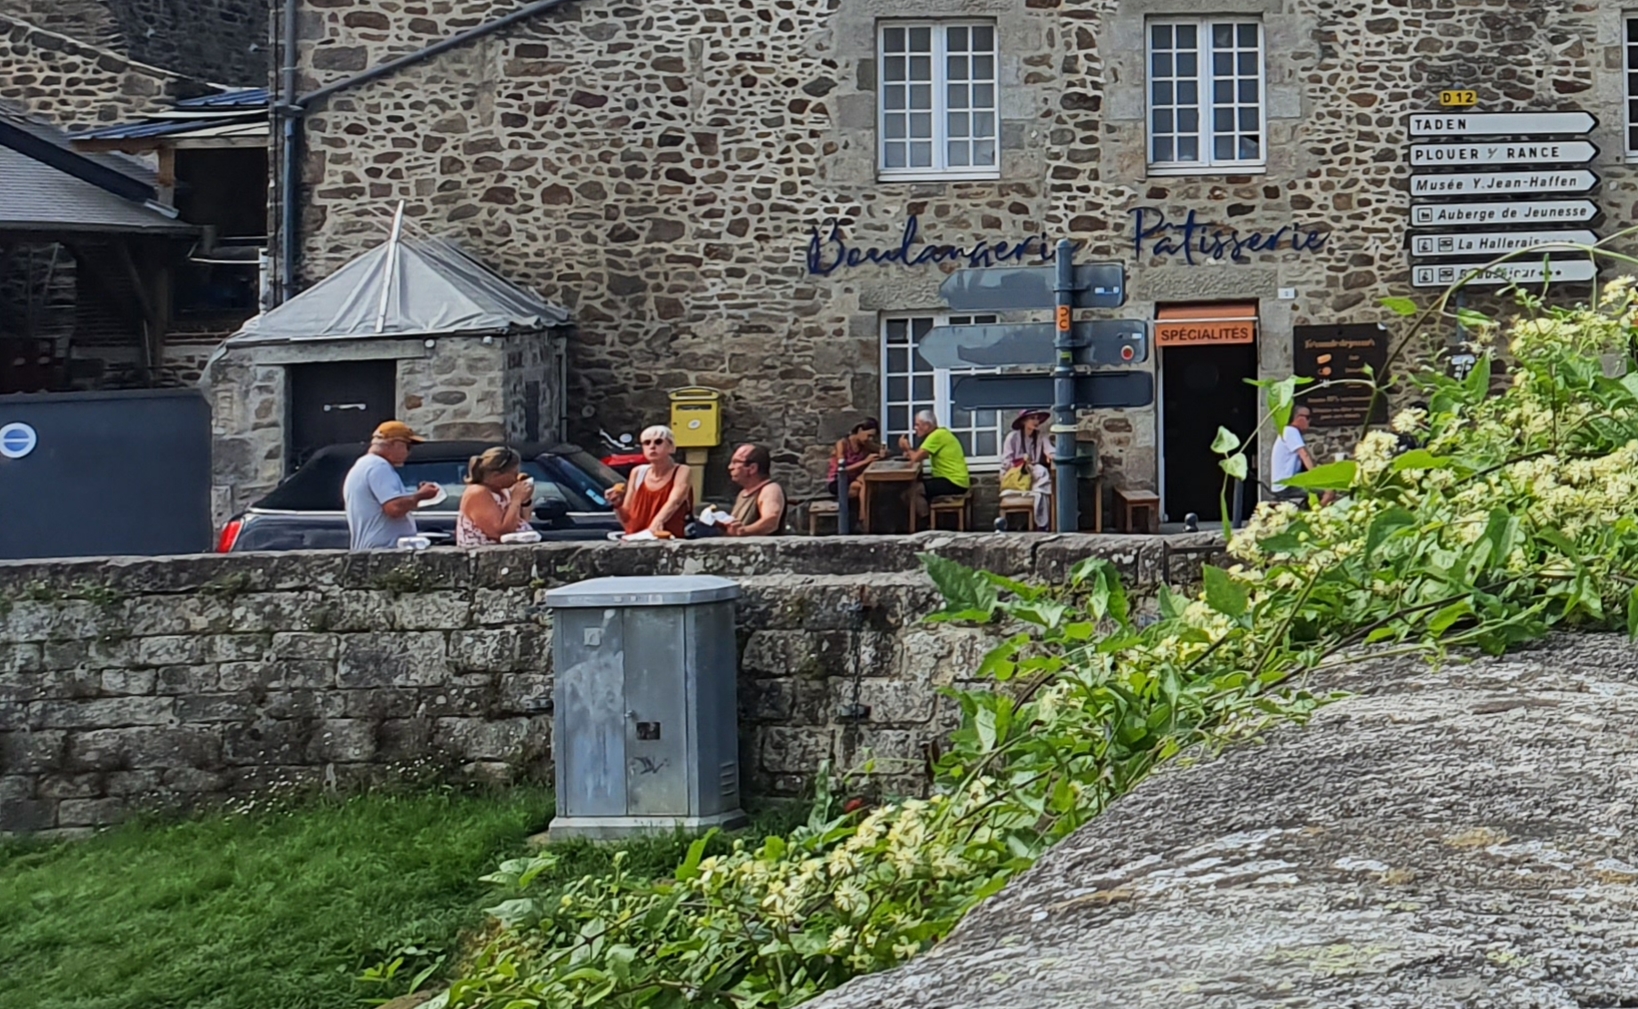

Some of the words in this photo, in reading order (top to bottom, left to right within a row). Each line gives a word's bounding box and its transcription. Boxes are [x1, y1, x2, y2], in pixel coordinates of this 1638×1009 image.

[1443, 92, 1452, 102] D
[1457, 92, 1474, 102] 12
[1415, 119, 1467, 130] TADEN
[1415, 147, 1479, 160] PLOUER
[1507, 146, 1560, 158] RANCE
[1415, 180, 1463, 191] Musée
[1437, 209, 1495, 221] Auberge
[1501, 207, 1518, 218] de
[1524, 206, 1587, 218] Jeunesse
[807, 214, 1081, 275] Boulangeri
[1458, 239, 1473, 250] La
[1479, 236, 1540, 250] Hallerais
[1161, 327, 1249, 341] SPÉCIALITÉS
